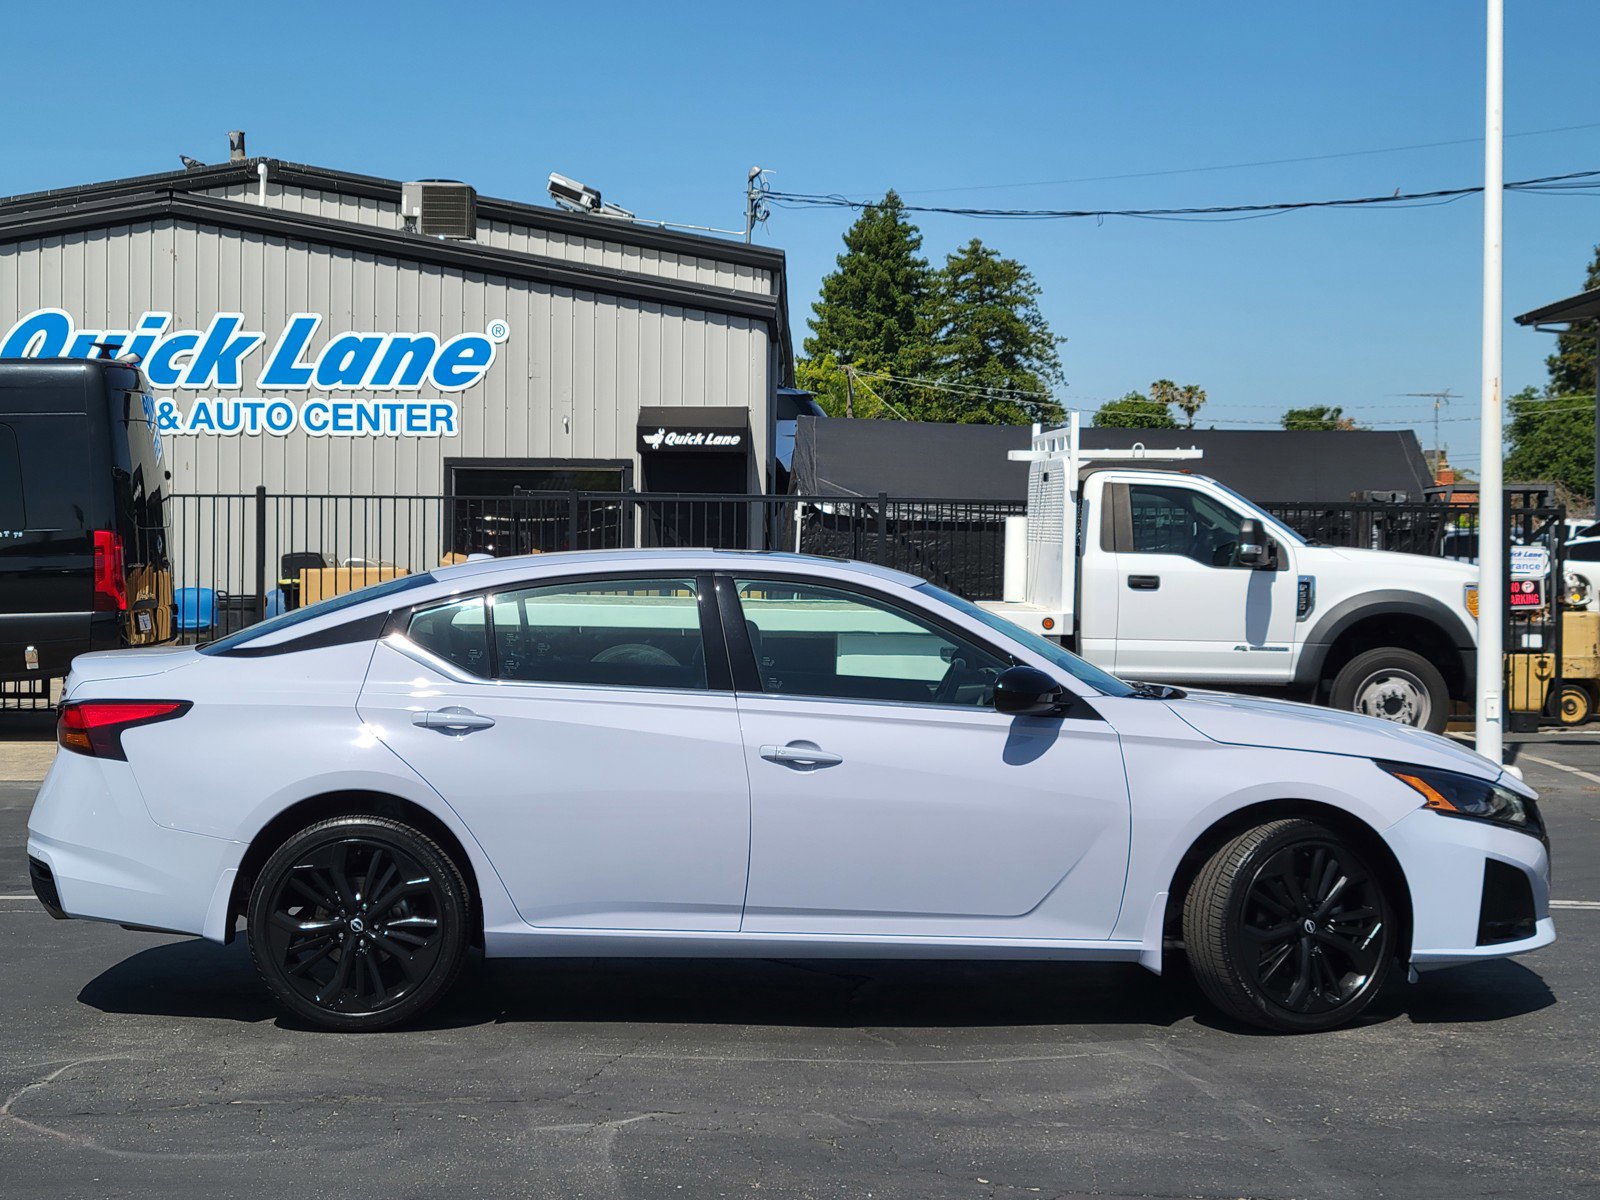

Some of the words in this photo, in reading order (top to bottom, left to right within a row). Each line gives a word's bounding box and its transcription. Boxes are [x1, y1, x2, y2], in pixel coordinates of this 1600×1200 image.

[158, 402, 179, 430] &
[189, 402, 293, 431] AUTO
[303, 402, 453, 431] CENTER
[664, 432, 705, 446] Quick
[704, 432, 741, 446] Lane
[1511, 593, 1539, 605] ARKING
